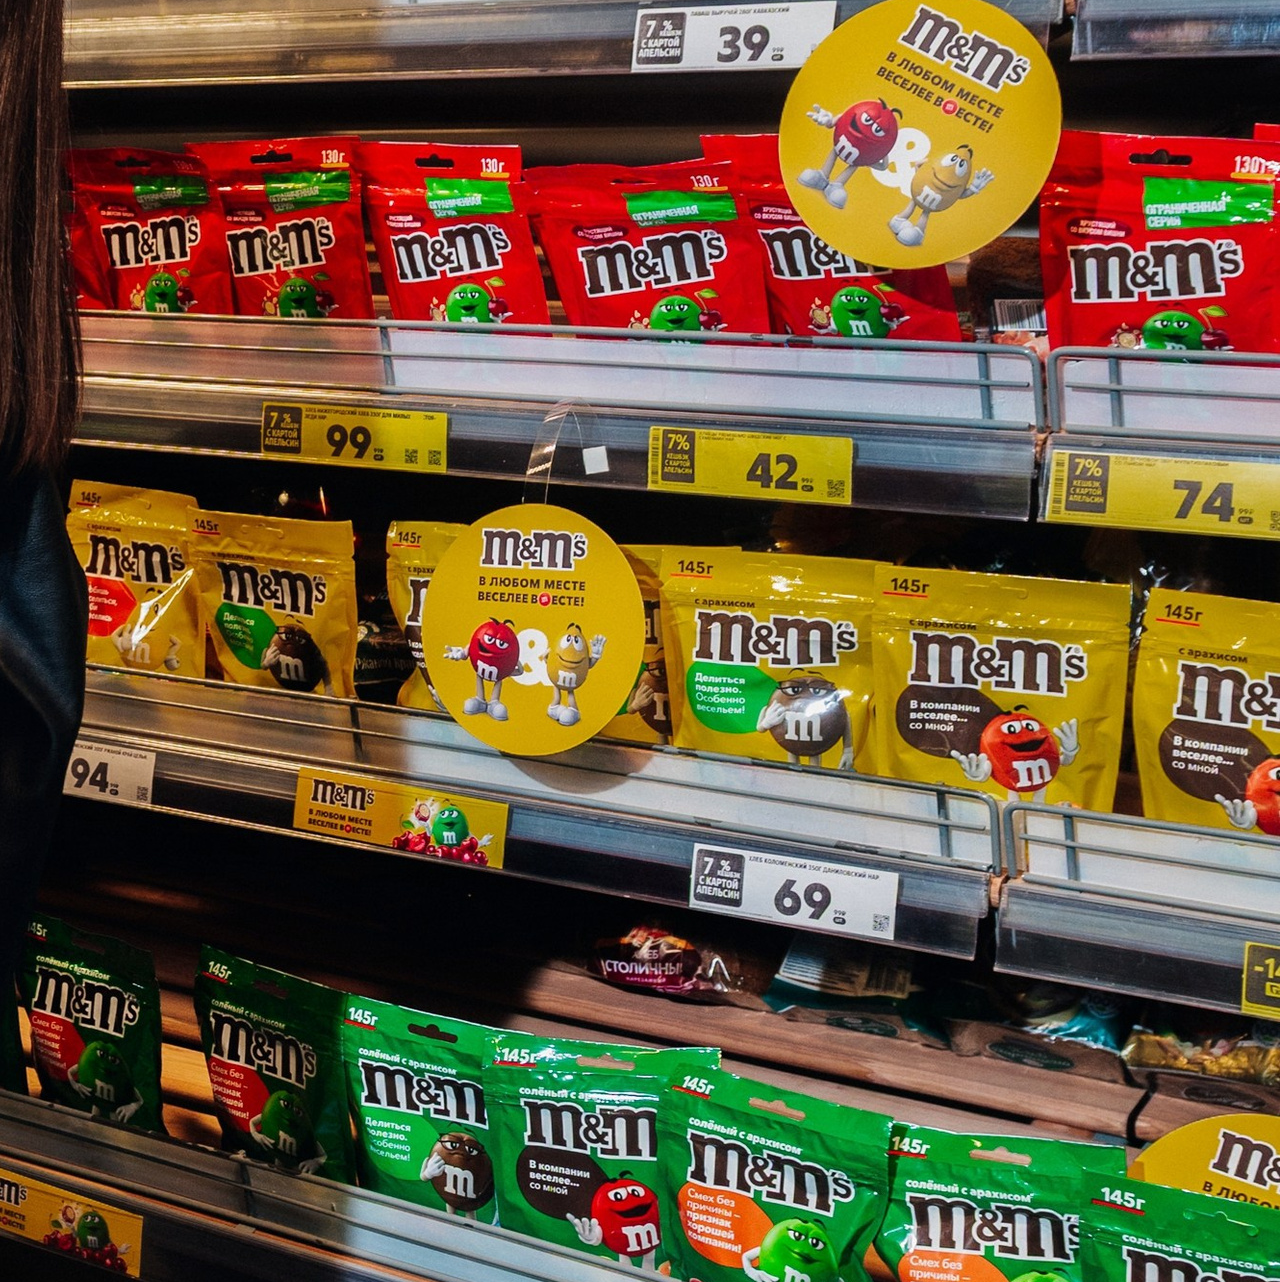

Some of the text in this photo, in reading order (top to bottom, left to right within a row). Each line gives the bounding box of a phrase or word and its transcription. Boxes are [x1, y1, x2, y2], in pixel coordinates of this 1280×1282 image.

[648, 36, 679, 47] КАРТОЙ
[717, 25, 770, 62] 39
[898, 3, 1031, 93] m&m's
[638, 48, 680, 58] АПЕЛЬСИН
[876, 66, 932, 103] ВЕСЕЛЕЕ
[886, 51, 1004, 119] В ЛЮБОМ МЕСТЕ
[429, 196, 482, 210] ОГРАНИЧЕННАЯ
[1145, 200, 1226, 215] ОГРАНИЧЕННАЯ
[632, 205, 700, 222] ОГРАНИЧЕННАЯ
[1147, 216, 1181, 228] СЕРИЯ
[100, 215, 201, 269] m&m's
[225, 217, 335, 278] m&m's
[390, 223, 511, 284] m&m's
[577, 229, 728, 299] m&m's
[1067, 238, 1244, 303] m&m's
[265, 438, 299, 448] АПЕЛЬСИН
[327, 424, 372, 459] 99
[667, 434, 690, 451] 7%
[664, 467, 692, 475] АПЕЛЬСИН
[746, 453, 798, 491] 42
[1074, 458, 1103, 476] 7%
[1073, 480, 1101, 488] КЕШБЭК
[80, 491, 102, 504] 145г
[1069, 495, 1104, 504] АПЕЛЬСИН
[1173, 480, 1235, 522] 74
[194, 519, 219, 533] 145г
[397, 530, 422, 544] 145г
[85, 533, 185, 584] m&m's
[480, 528, 588, 571] m&m's
[677, 560, 714, 575] 145г
[216, 560, 326, 618] m&m's
[478, 576, 586, 591] В ЛЮБОМ МЕСТЕ
[890, 578, 930, 594] 145г
[478, 591, 528, 604] ВЕСЕЛЕЕ
[1164, 604, 1203, 622] 145г
[693, 608, 858, 669] m&m's
[908, 630, 1088, 698] m&m's
[1179, 647, 1248, 663] с арахисом
[695, 673, 745, 685] Делиться
[695, 684, 741, 694] полезно.
[696, 692, 745, 704] Особенно
[697, 704, 745, 714] весельем!
[910, 700, 980, 713] В компании
[910, 711, 968, 722] веселее...
[909, 722, 954, 732] со мной
[1173, 736, 1249, 756] В компании
[1173, 748, 1234, 766] веселее...
[71, 758, 109, 793] 94
[1172, 760, 1219, 775] со мной
[311, 778, 375, 811] m&m's
[315, 810, 346, 821] ЛЮБОМ
[348, 816, 372, 827] МЕСТЕ
[749, 856, 763, 864] ХЛЕБ
[764, 858, 807, 869] КОЛОМЕНСКИЙ
[822, 866, 867, 879] ДАНИЛОВСКИЙ
[706, 877, 738, 889] КАРТОЙ
[696, 885, 740, 900] АПЕЛЬСИН
[774, 879, 832, 920] 69
[208, 961, 232, 979] 145г
[31, 965, 140, 1038] m&m's
[349, 1007, 378, 1026] 145г
[210, 1009, 317, 1090] m&m's
[683, 1075, 715, 1095] 145г
[689, 1116, 803, 1155] солёный с арахисом
[892, 1135, 930, 1155] 145г
[529, 1160, 591, 1179] В компании
[687, 1128, 855, 1217] m&m's
[529, 1170, 580, 1188] веселее...
[529, 1181, 568, 1196] со мной
[906, 1179, 959, 1194] солёный
[970, 1187, 1032, 1203] арахисом
[688, 1188, 736, 1208] Смех без
[1101, 1187, 1146, 1211] 145г
[686, 1211, 732, 1229] признак
[688, 1221, 735, 1241] хорошей
[1122, 1233, 1265, 1272] солёный с арахисом
[909, 1255, 963, 1270] Смех без
